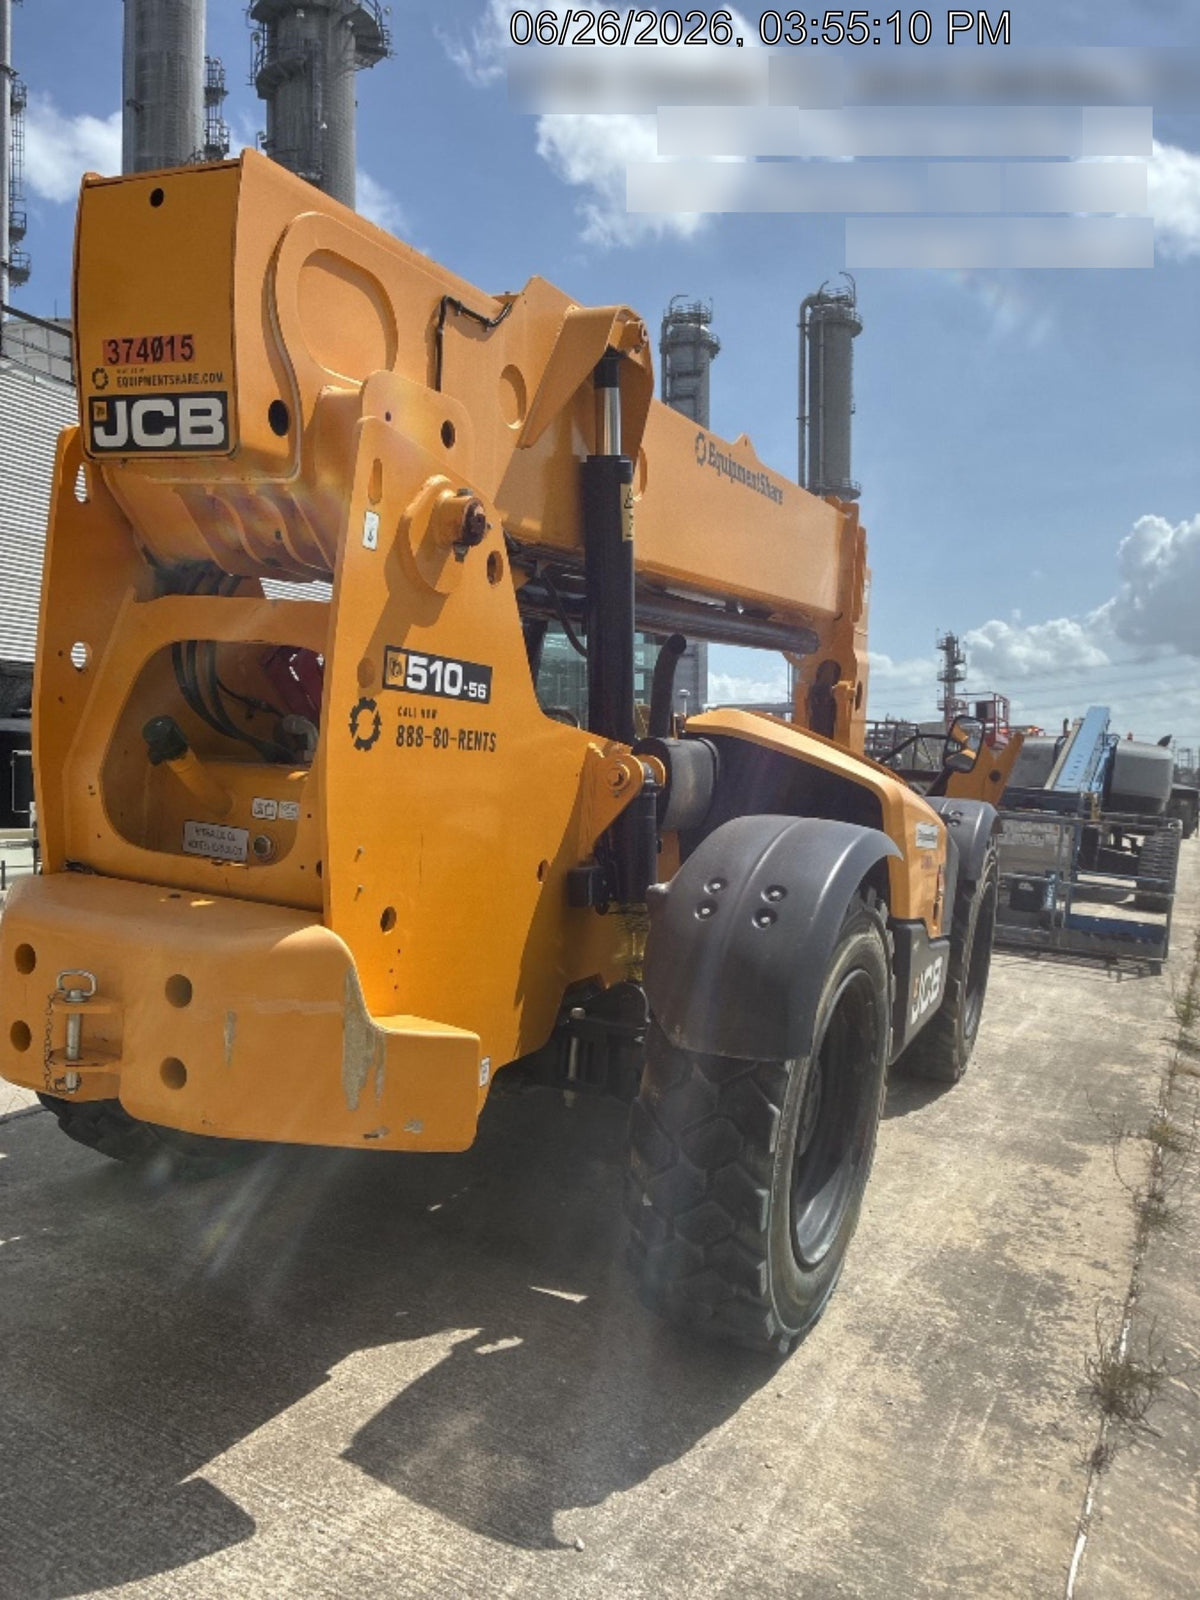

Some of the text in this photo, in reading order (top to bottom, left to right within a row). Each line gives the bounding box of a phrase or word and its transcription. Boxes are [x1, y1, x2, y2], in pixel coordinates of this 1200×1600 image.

[107, 334, 194, 364] 374015
[117, 372, 223, 388] EQUIPMENTSHARE.COM
[92, 397, 225, 448] JCB
[707, 440, 783, 505] EquipmentShare
[397, 706, 437, 719] CALL NOW
[396, 724, 497, 752] 888-80-RENTS
